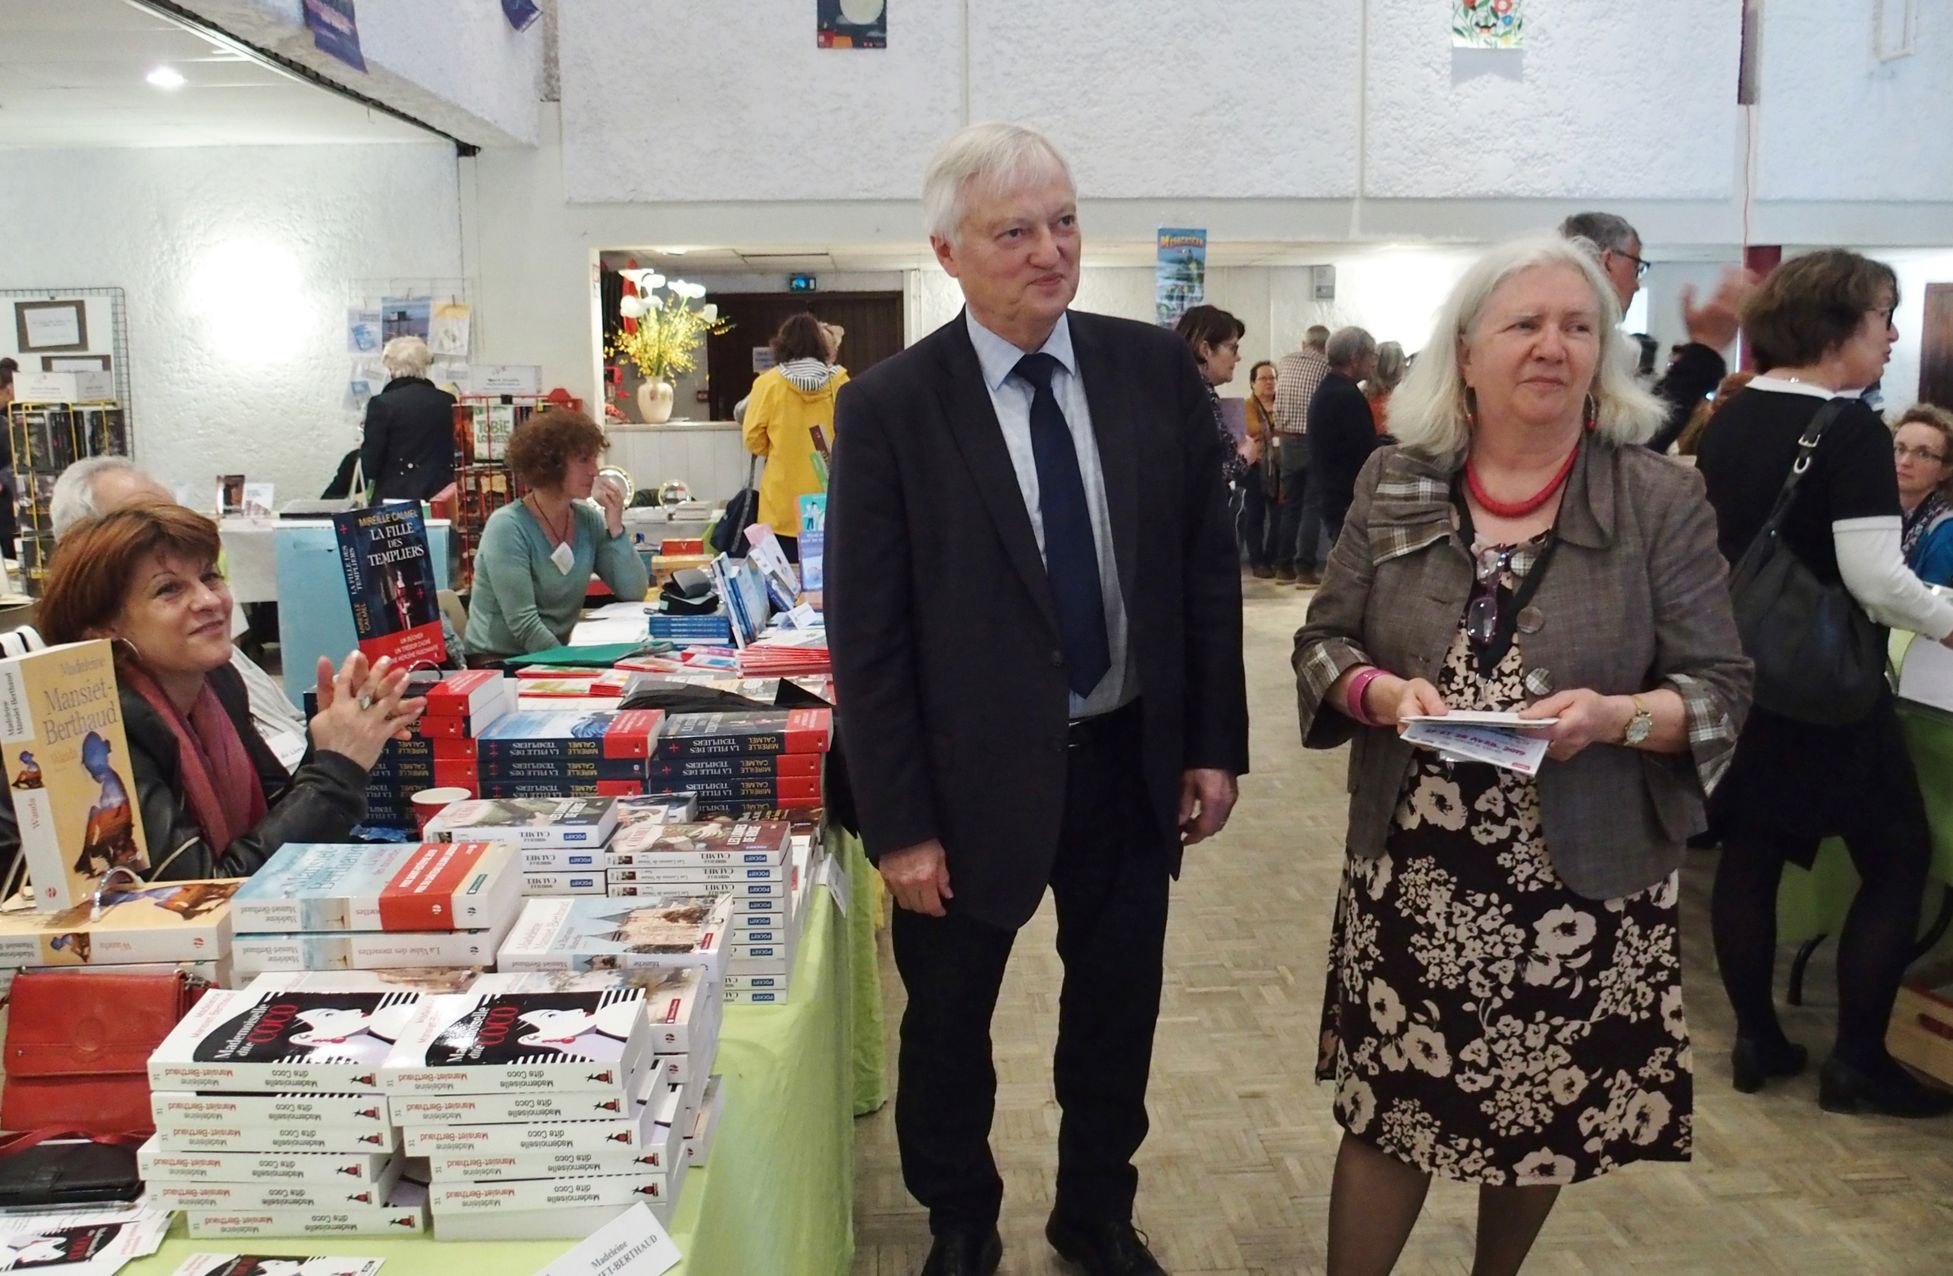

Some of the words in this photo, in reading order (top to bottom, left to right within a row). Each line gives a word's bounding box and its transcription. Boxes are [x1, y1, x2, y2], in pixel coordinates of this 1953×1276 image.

[359, 515, 390, 527] MIREILLE
[391, 510, 419, 521] CALMEL
[370, 528, 384, 541] LA
[386, 522, 414, 538] FILLE
[387, 537, 403, 549] DES
[367, 544, 425, 567] TEMPLIERS
[43, 679, 113, 716] Mansiet-
[42, 700, 118, 746] Berthaud
[692, 738, 736, 746] TEMPLIERS
[685, 761, 729, 769] TEMPLIERS
[685, 782, 729, 790] TEMPLIERS
[395, 947, 408, 955] des
[429, 946, 441, 955] La
[214, 1002, 270, 1059] Mademoiselle
[165, 1068, 233, 1077] Mansiet-Berthaud
[293, 1069, 309, 1077] dite
[399, 1072, 468, 1081] Mansiet-Berthaud
[506, 1070, 526, 1078] Coco
[528, 1070, 544, 1078] dite
[181, 1078, 219, 1086] Madeleine
[264, 1079, 318, 1088] Mademoiselle
[414, 1082, 454, 1090] Madeleine
[499, 1080, 554, 1089] Mademoiselle
[168, 1102, 237, 1111] Mansiet-Berthaud
[297, 1103, 312, 1111] dite
[406, 1102, 475, 1111] Mansiet-Berthaud
[514, 1099, 534, 1107] Coco
[536, 1099, 552, 1107] dite
[184, 1112, 223, 1120] Madeleine
[268, 1112, 322, 1121] Mademoiselle
[422, 1111, 462, 1119] Madeleine
[507, 1108, 561, 1117] Mademoiselle
[173, 1128, 241, 1137] Mansiet-Berthaud
[279, 1129, 298, 1137] Coco
[301, 1129, 316, 1137] dite
[420, 1132, 489, 1141] Mansiet-Berthaud
[527, 1129, 546, 1137] Coco
[549, 1129, 565, 1137] dite
[189, 1138, 227, 1146] Madeleine
[272, 1138, 325, 1147] Mademoiselle
[436, 1142, 475, 1150] Madeleine
[520, 1139, 574, 1148] Mademoiselle
[447, 1157, 516, 1167] Mansiet-Berthaud
[554, 1154, 574, 1163] Coco
[576, 1154, 592, 1162] dite
[153, 1159, 221, 1168] Mansiet-Berthaud
[258, 1160, 278, 1168] Coco
[281, 1160, 296, 1168] dite
[547, 1163, 601, 1172] Mademoiselle
[169, 1168, 207, 1177] Madeleine
[252, 1170, 304, 1178] Mademoiselle
[463, 1167, 502, 1176] Madeleine
[163, 1188, 230, 1197] Mansiet-Berthaud
[268, 1189, 287, 1197] Coco
[290, 1189, 306, 1197] dite
[554, 1184, 573, 1193] Coco
[576, 1184, 591, 1193] dite
[446, 1188, 515, 1199] Mansiet-Berthaud
[178, 1198, 217, 1206] Madeleine
[462, 1198, 501, 1206] Madeleine
[547, 1194, 601, 1203] Mademoiselle
[205, 1216, 273, 1225] Mansiet-Berthaud
[311, 1214, 330, 1222] Coco
[333, 1214, 348, 1222] dite
[220, 1226, 259, 1234] Madeleine
[304, 1223, 358, 1232] Mademoiselle
[591, 1240, 628, 1268] Madeleine
